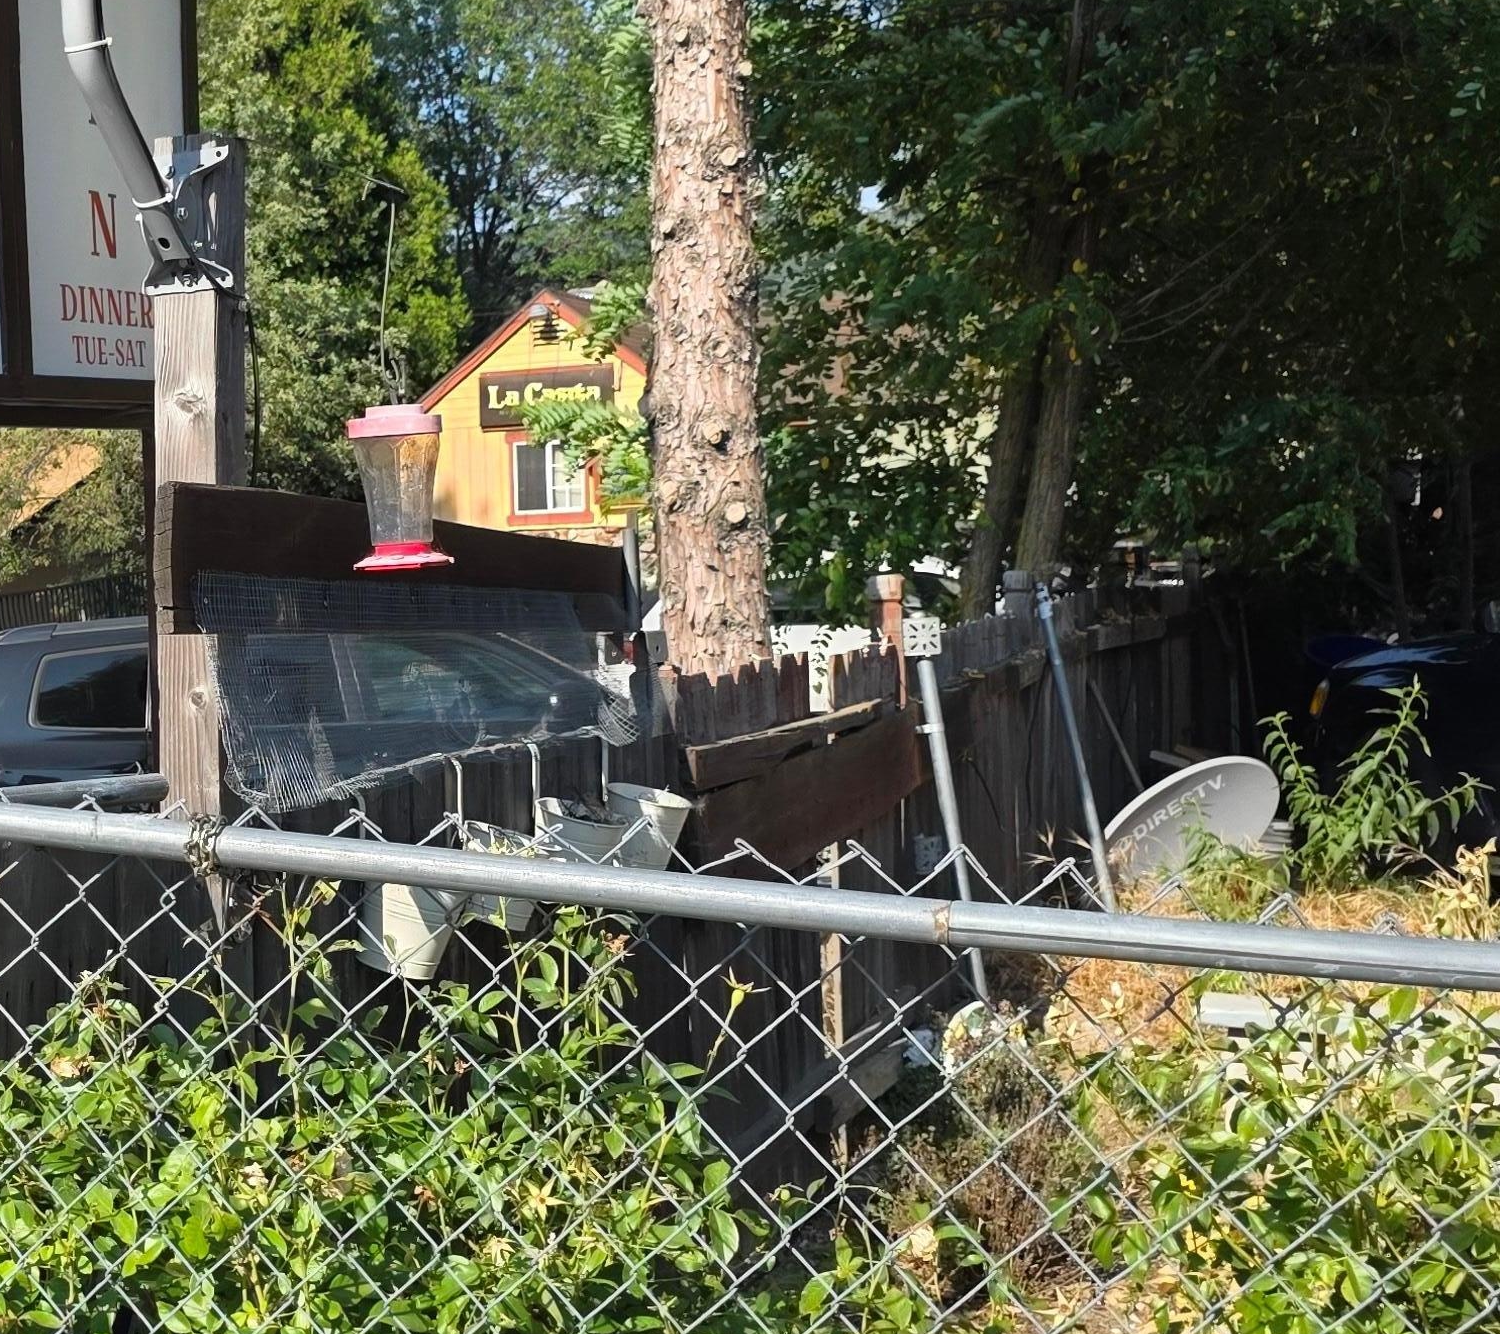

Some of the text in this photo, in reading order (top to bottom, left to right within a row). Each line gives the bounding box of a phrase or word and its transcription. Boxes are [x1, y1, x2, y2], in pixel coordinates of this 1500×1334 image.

[59, 283, 155, 329] DINNER
[71, 334, 147, 368] TUE-SAT
[488, 385, 519, 409] La
